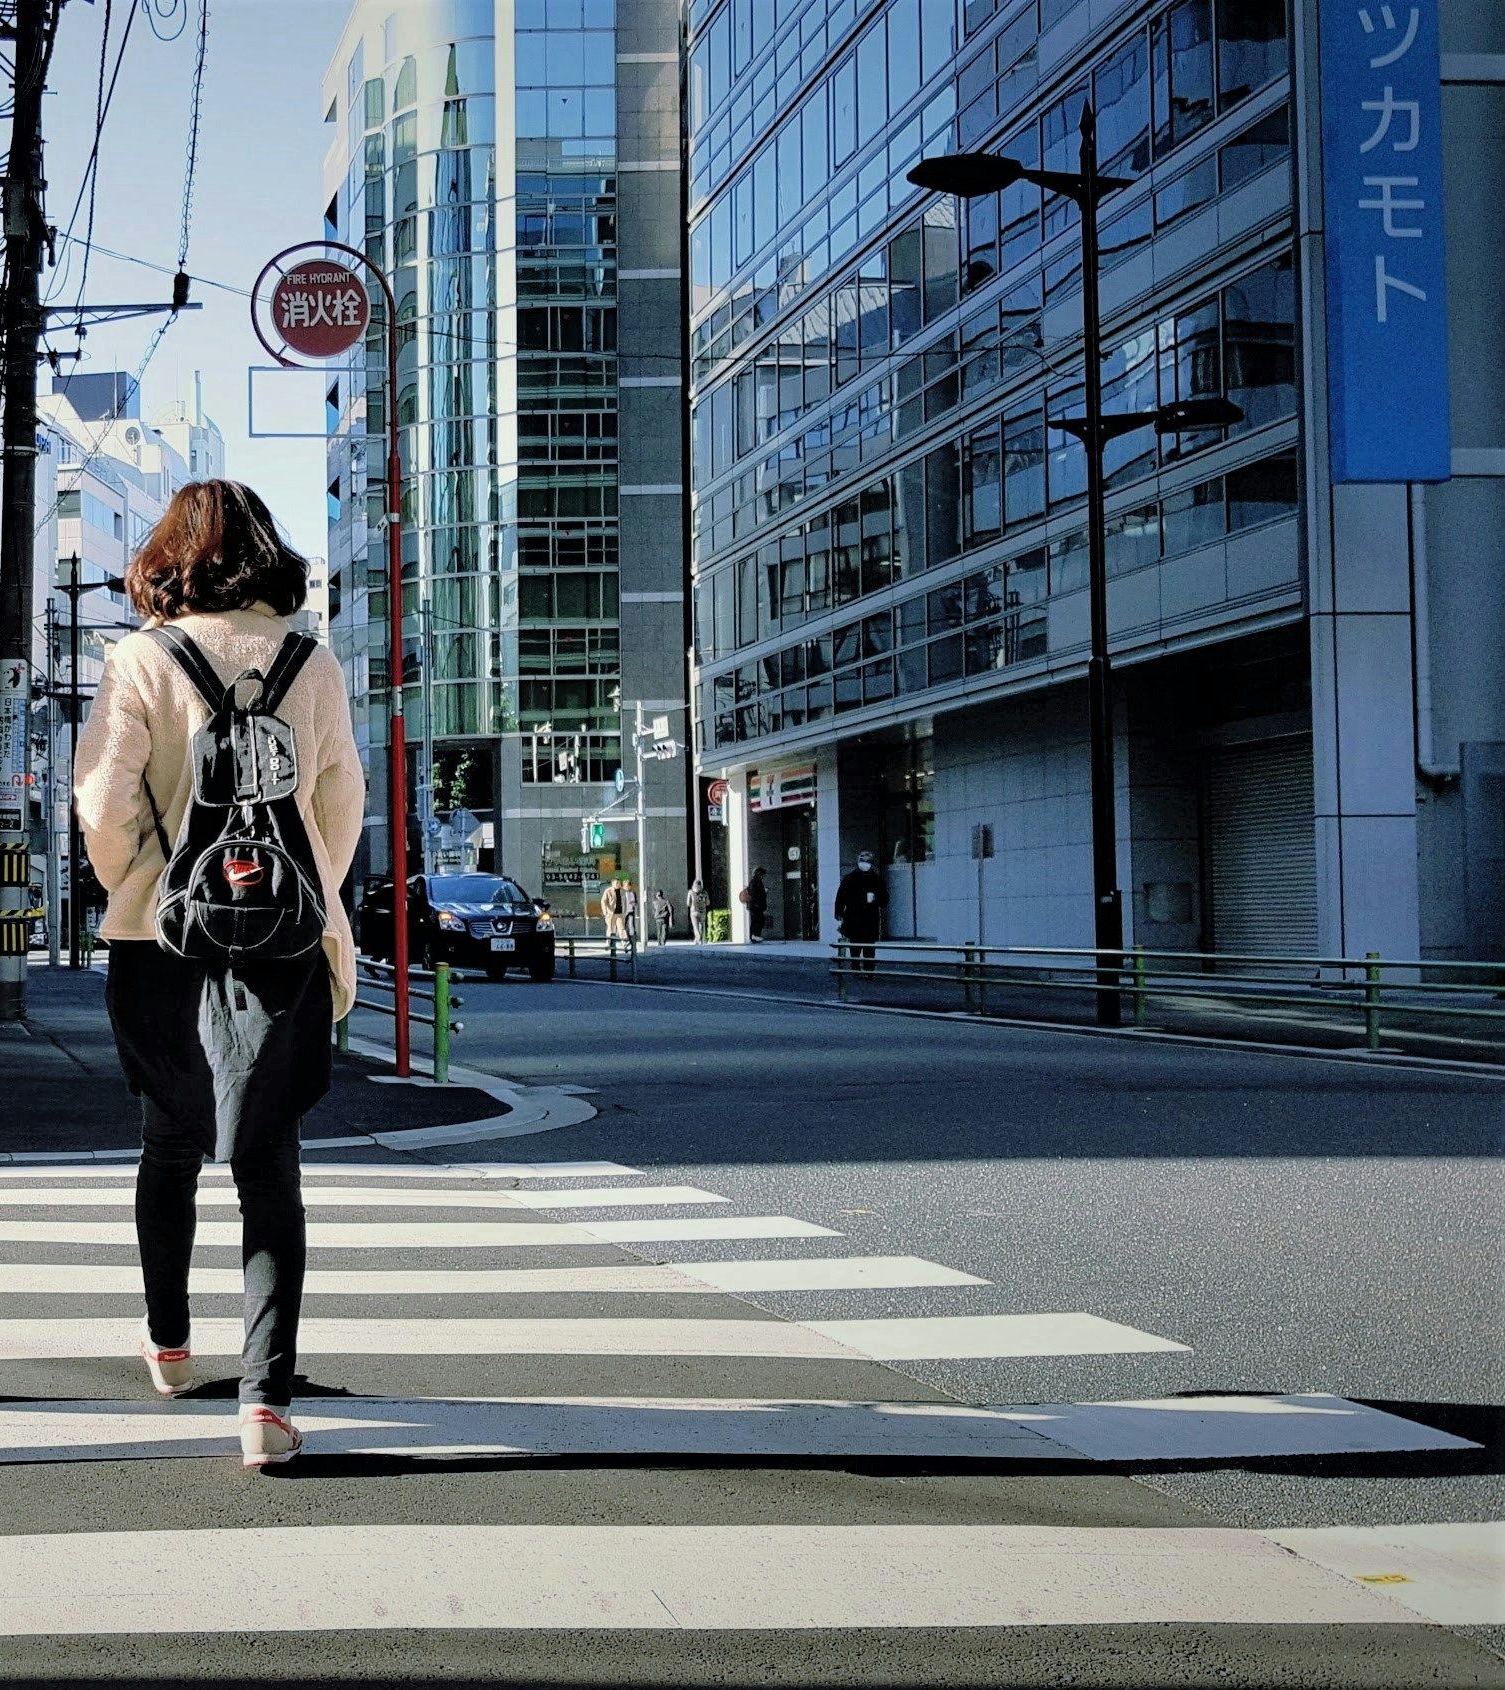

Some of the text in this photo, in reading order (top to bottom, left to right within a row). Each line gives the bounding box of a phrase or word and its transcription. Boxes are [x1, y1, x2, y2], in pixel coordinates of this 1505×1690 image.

[1358, 5, 1426, 323] ツカモト
[287, 272, 351, 285] FIRE HYDRANT
[281, 289, 361, 329] 消火栓
